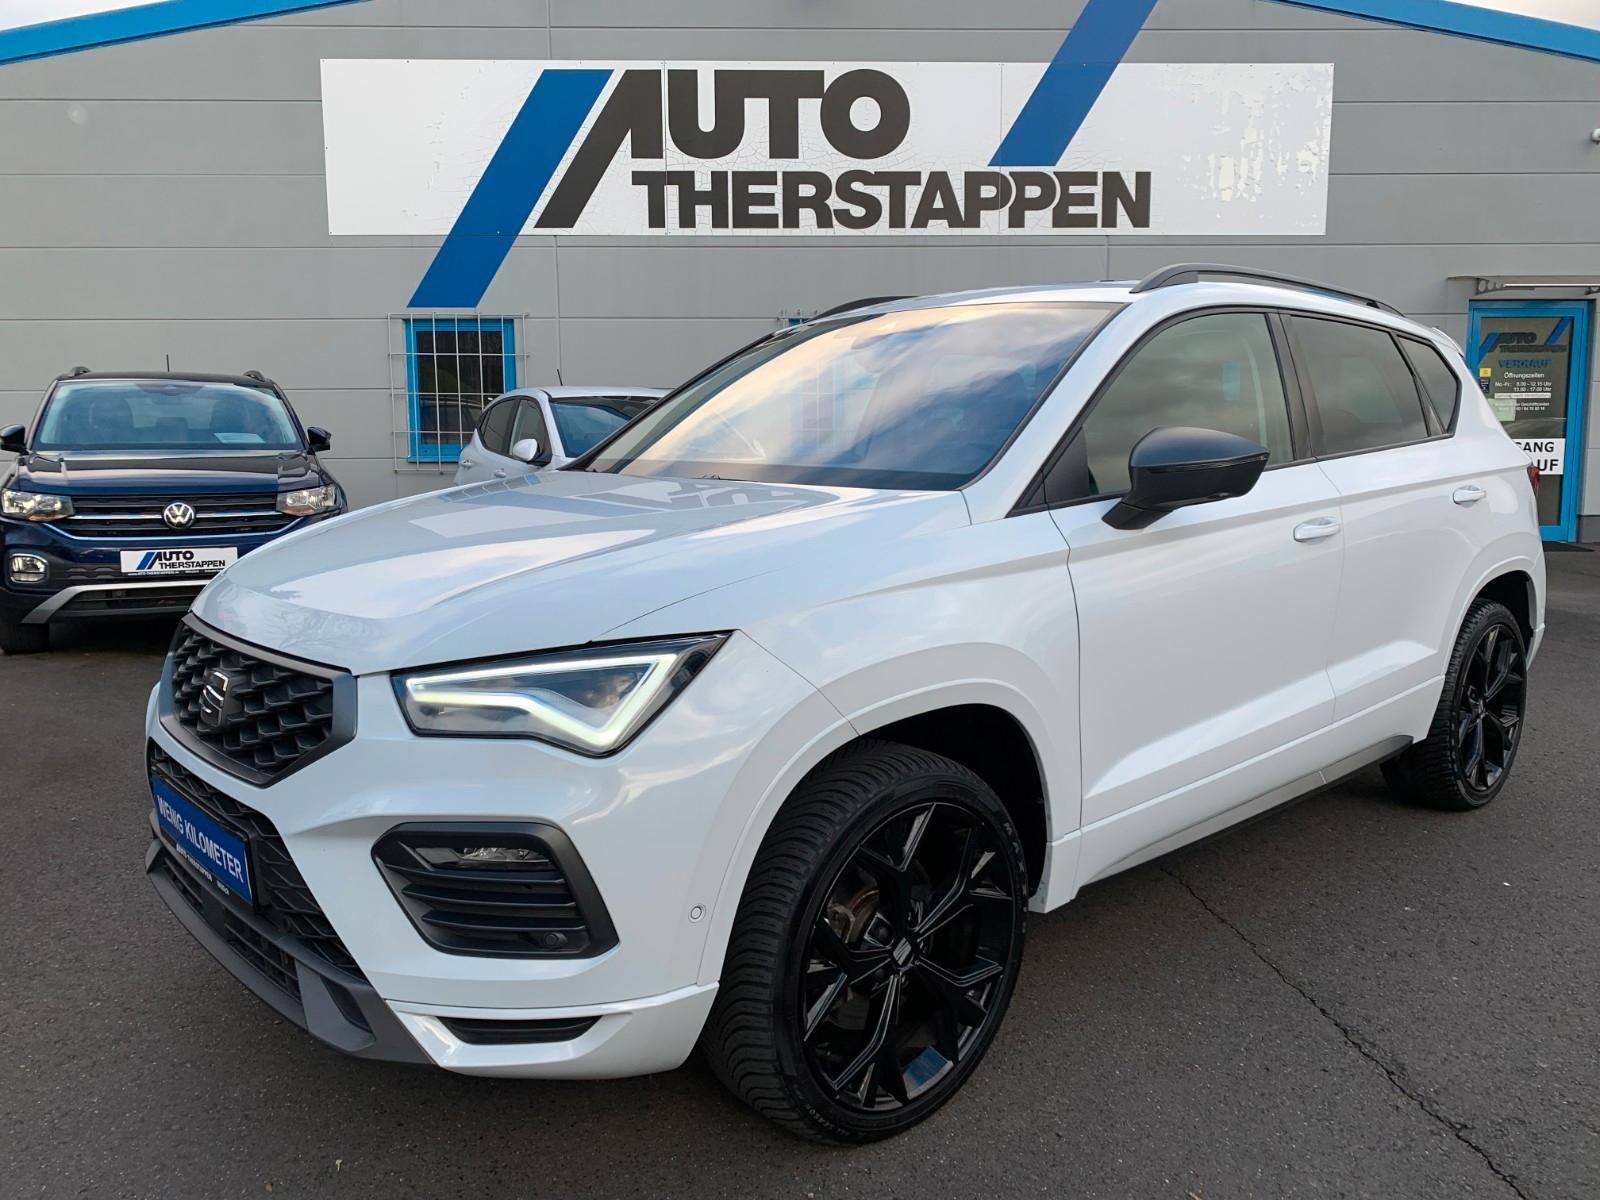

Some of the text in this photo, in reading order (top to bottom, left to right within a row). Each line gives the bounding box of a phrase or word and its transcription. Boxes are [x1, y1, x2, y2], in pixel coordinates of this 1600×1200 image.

[534, 69, 911, 230] AUTO
[632, 170, 1152, 230] THERSTAPPEN
[1515, 441, 1555, 453] ANG
[147, 550, 194, 569] AUTO
[158, 560, 226, 569] THERSTAPPEN
[157, 794, 185, 835] WENIG
[185, 819, 244, 884] KILOMETER
